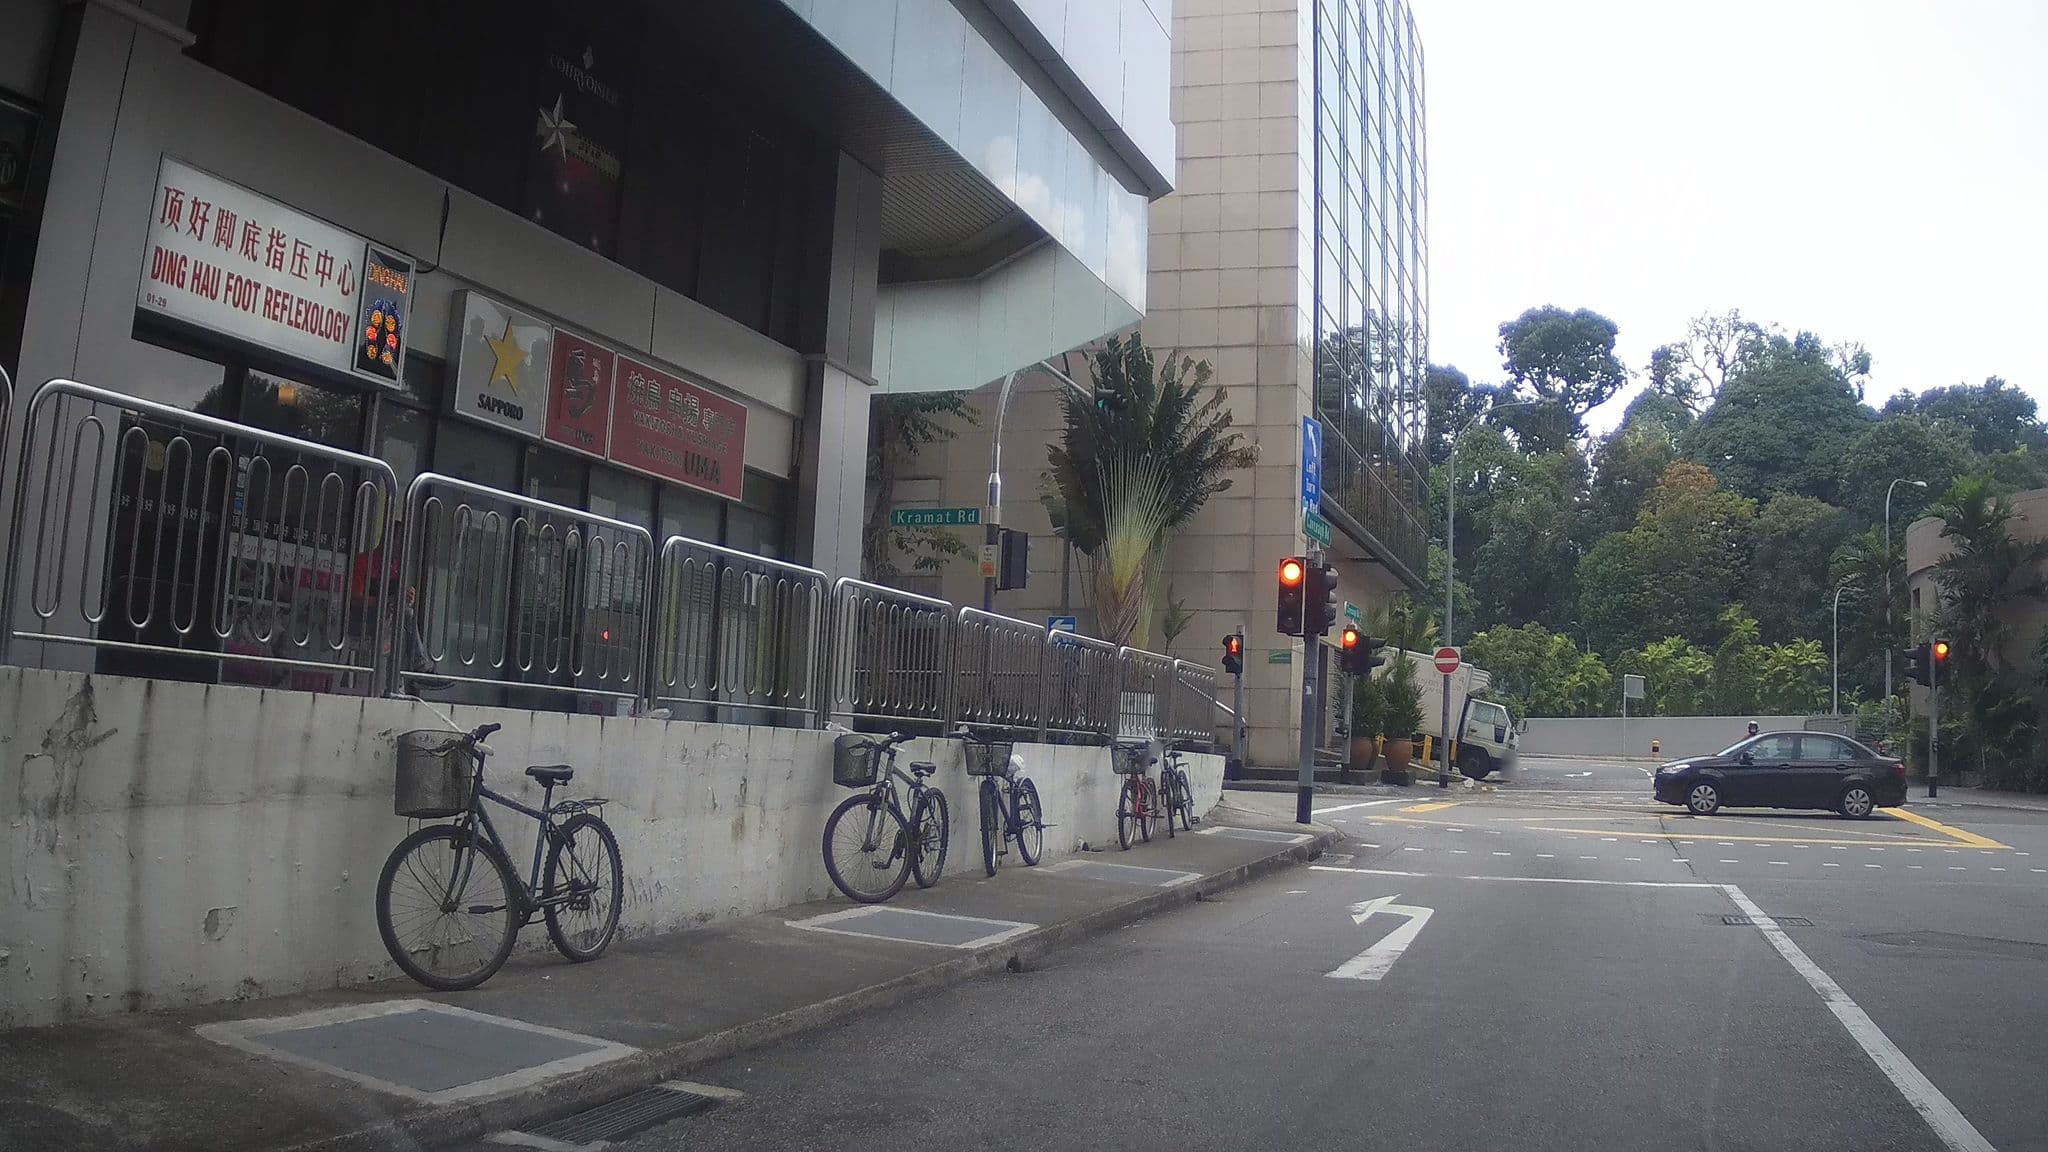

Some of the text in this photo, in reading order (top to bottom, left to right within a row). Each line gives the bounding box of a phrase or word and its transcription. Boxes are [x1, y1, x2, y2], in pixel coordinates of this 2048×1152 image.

[159, 186, 355, 297] 顶好脚底指压中心
[146, 292, 167, 308] 01-29
[151, 246, 350, 344] DING HAU FOOT REFLEXOLOGY
[477, 392, 524, 422] SAPPORO
[684, 450, 720, 485] UMA
[896, 509, 976, 524] Kramat Rd
